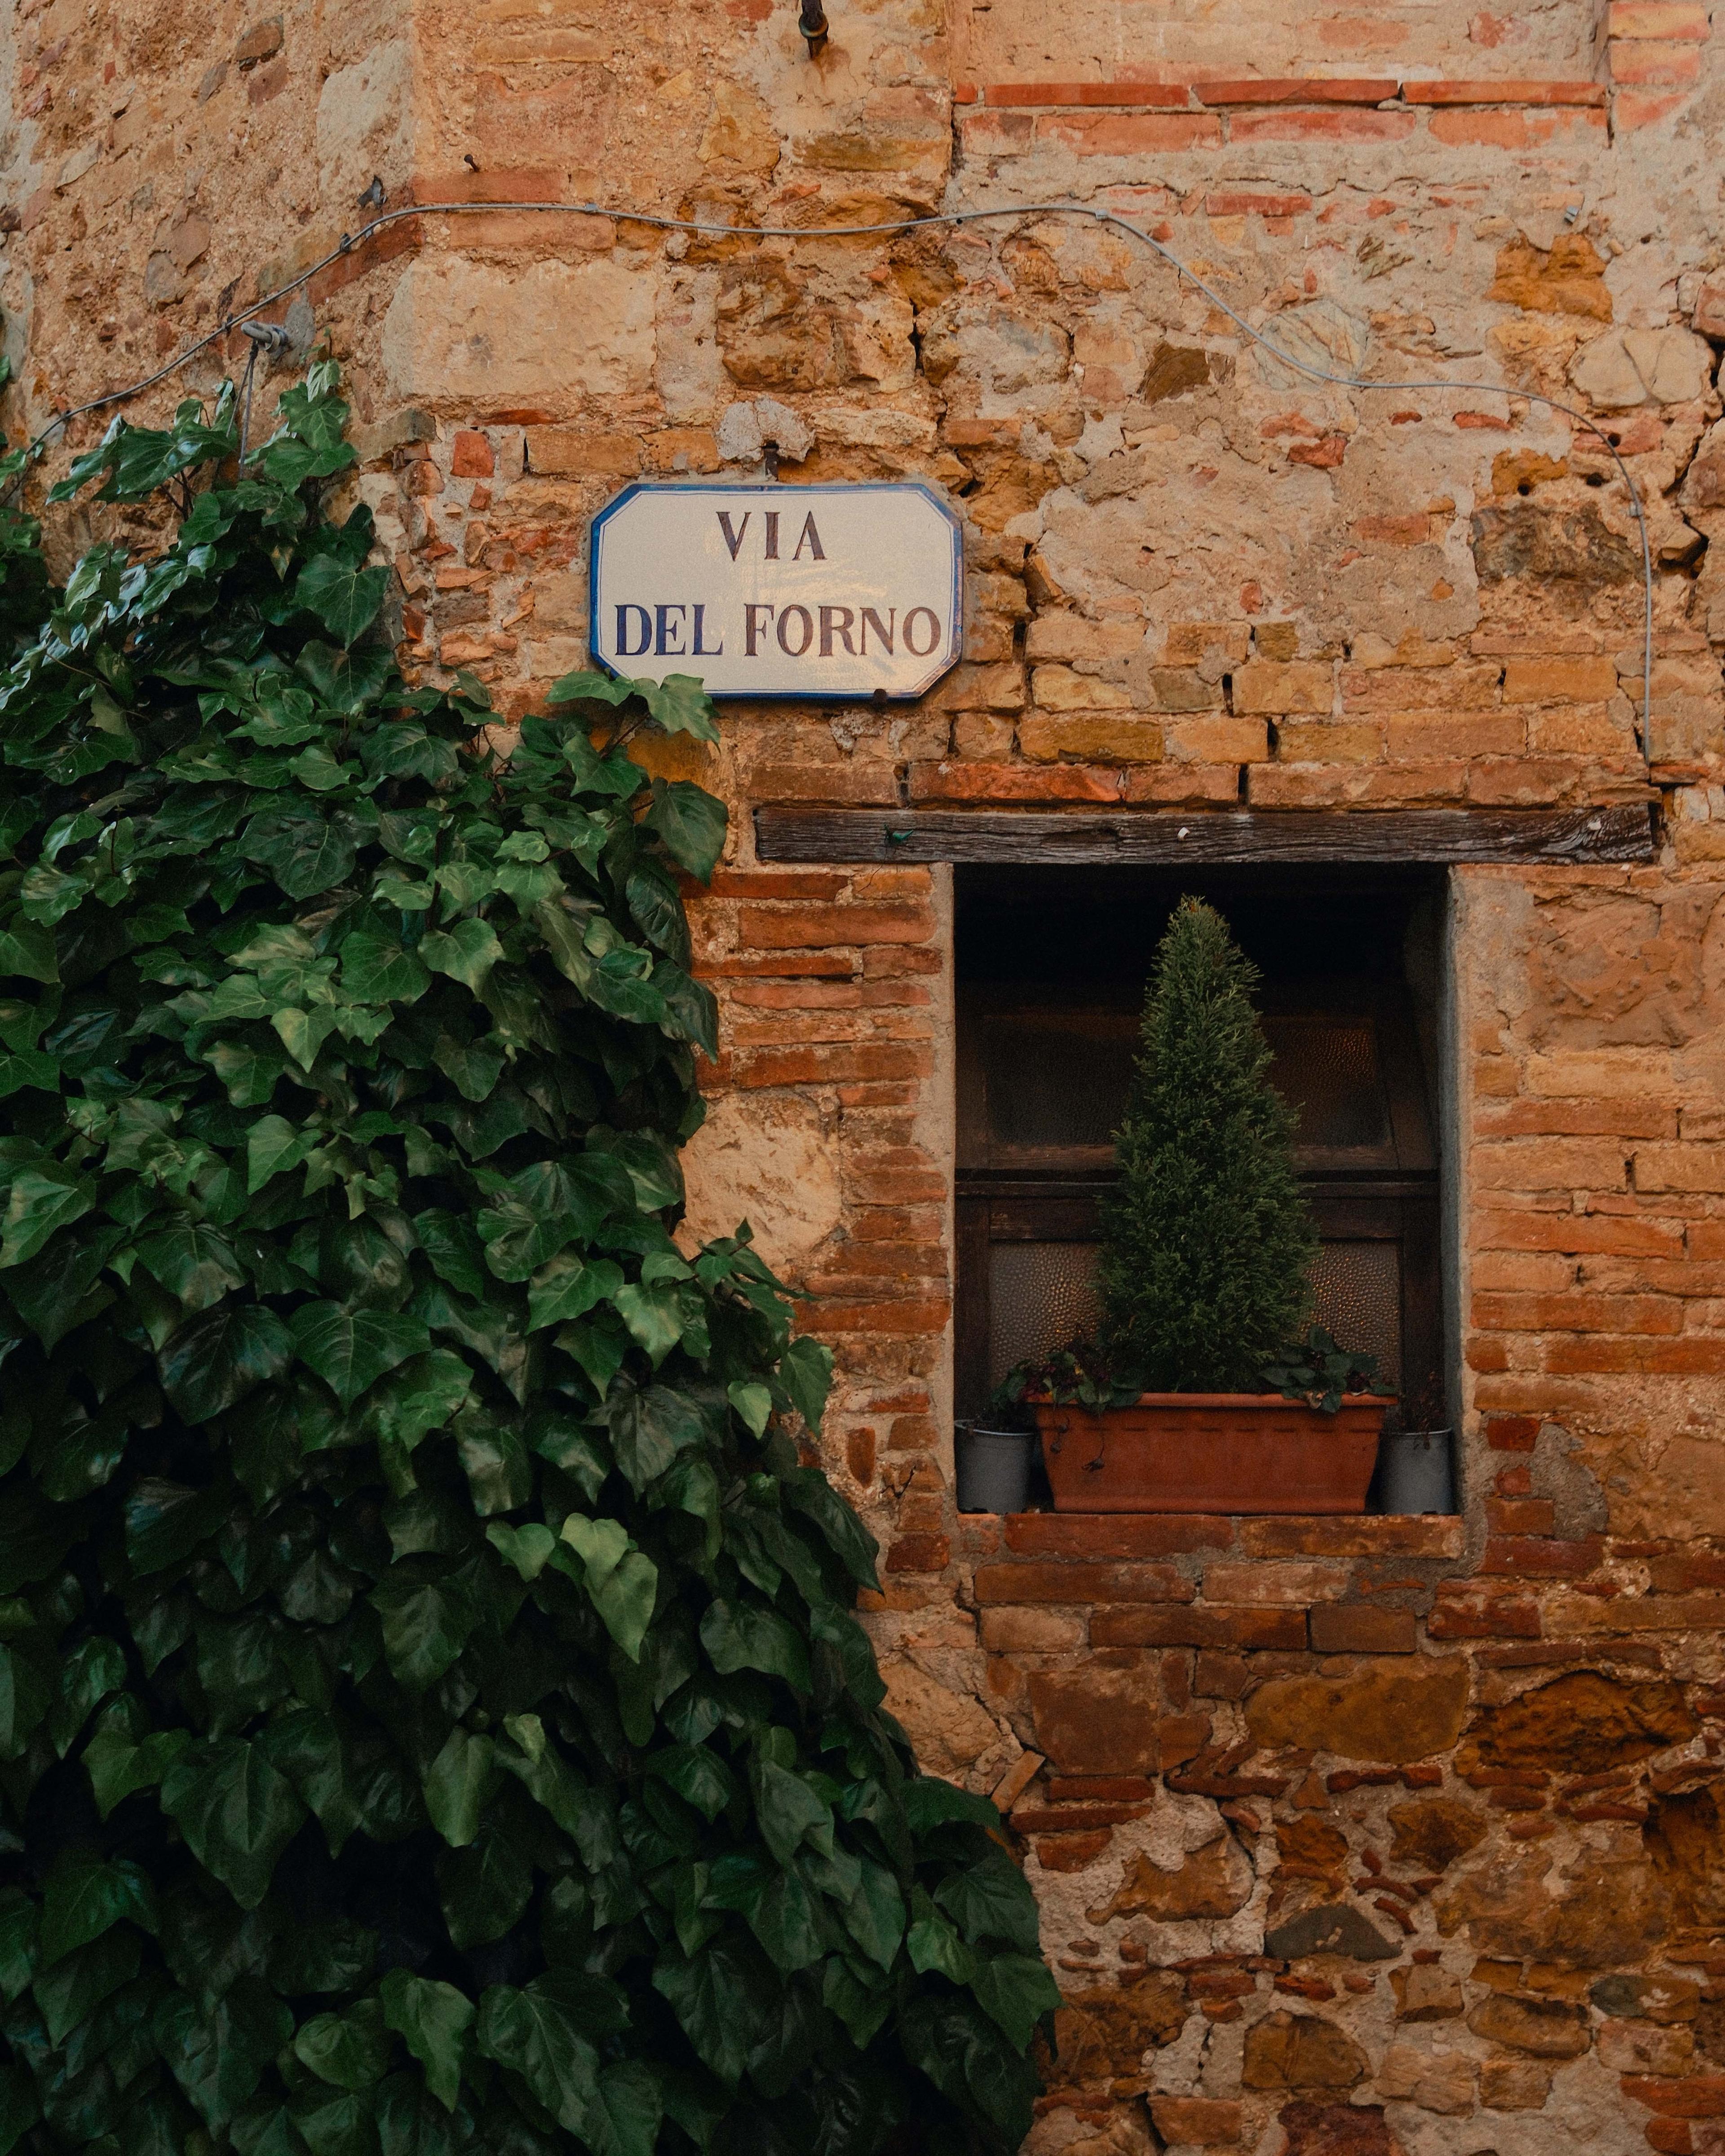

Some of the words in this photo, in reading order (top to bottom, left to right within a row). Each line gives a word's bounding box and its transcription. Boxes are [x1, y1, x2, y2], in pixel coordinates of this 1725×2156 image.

[716, 511, 827, 561] VIA
[615, 604, 723, 656] DEL
[743, 603, 942, 657] FORNO
